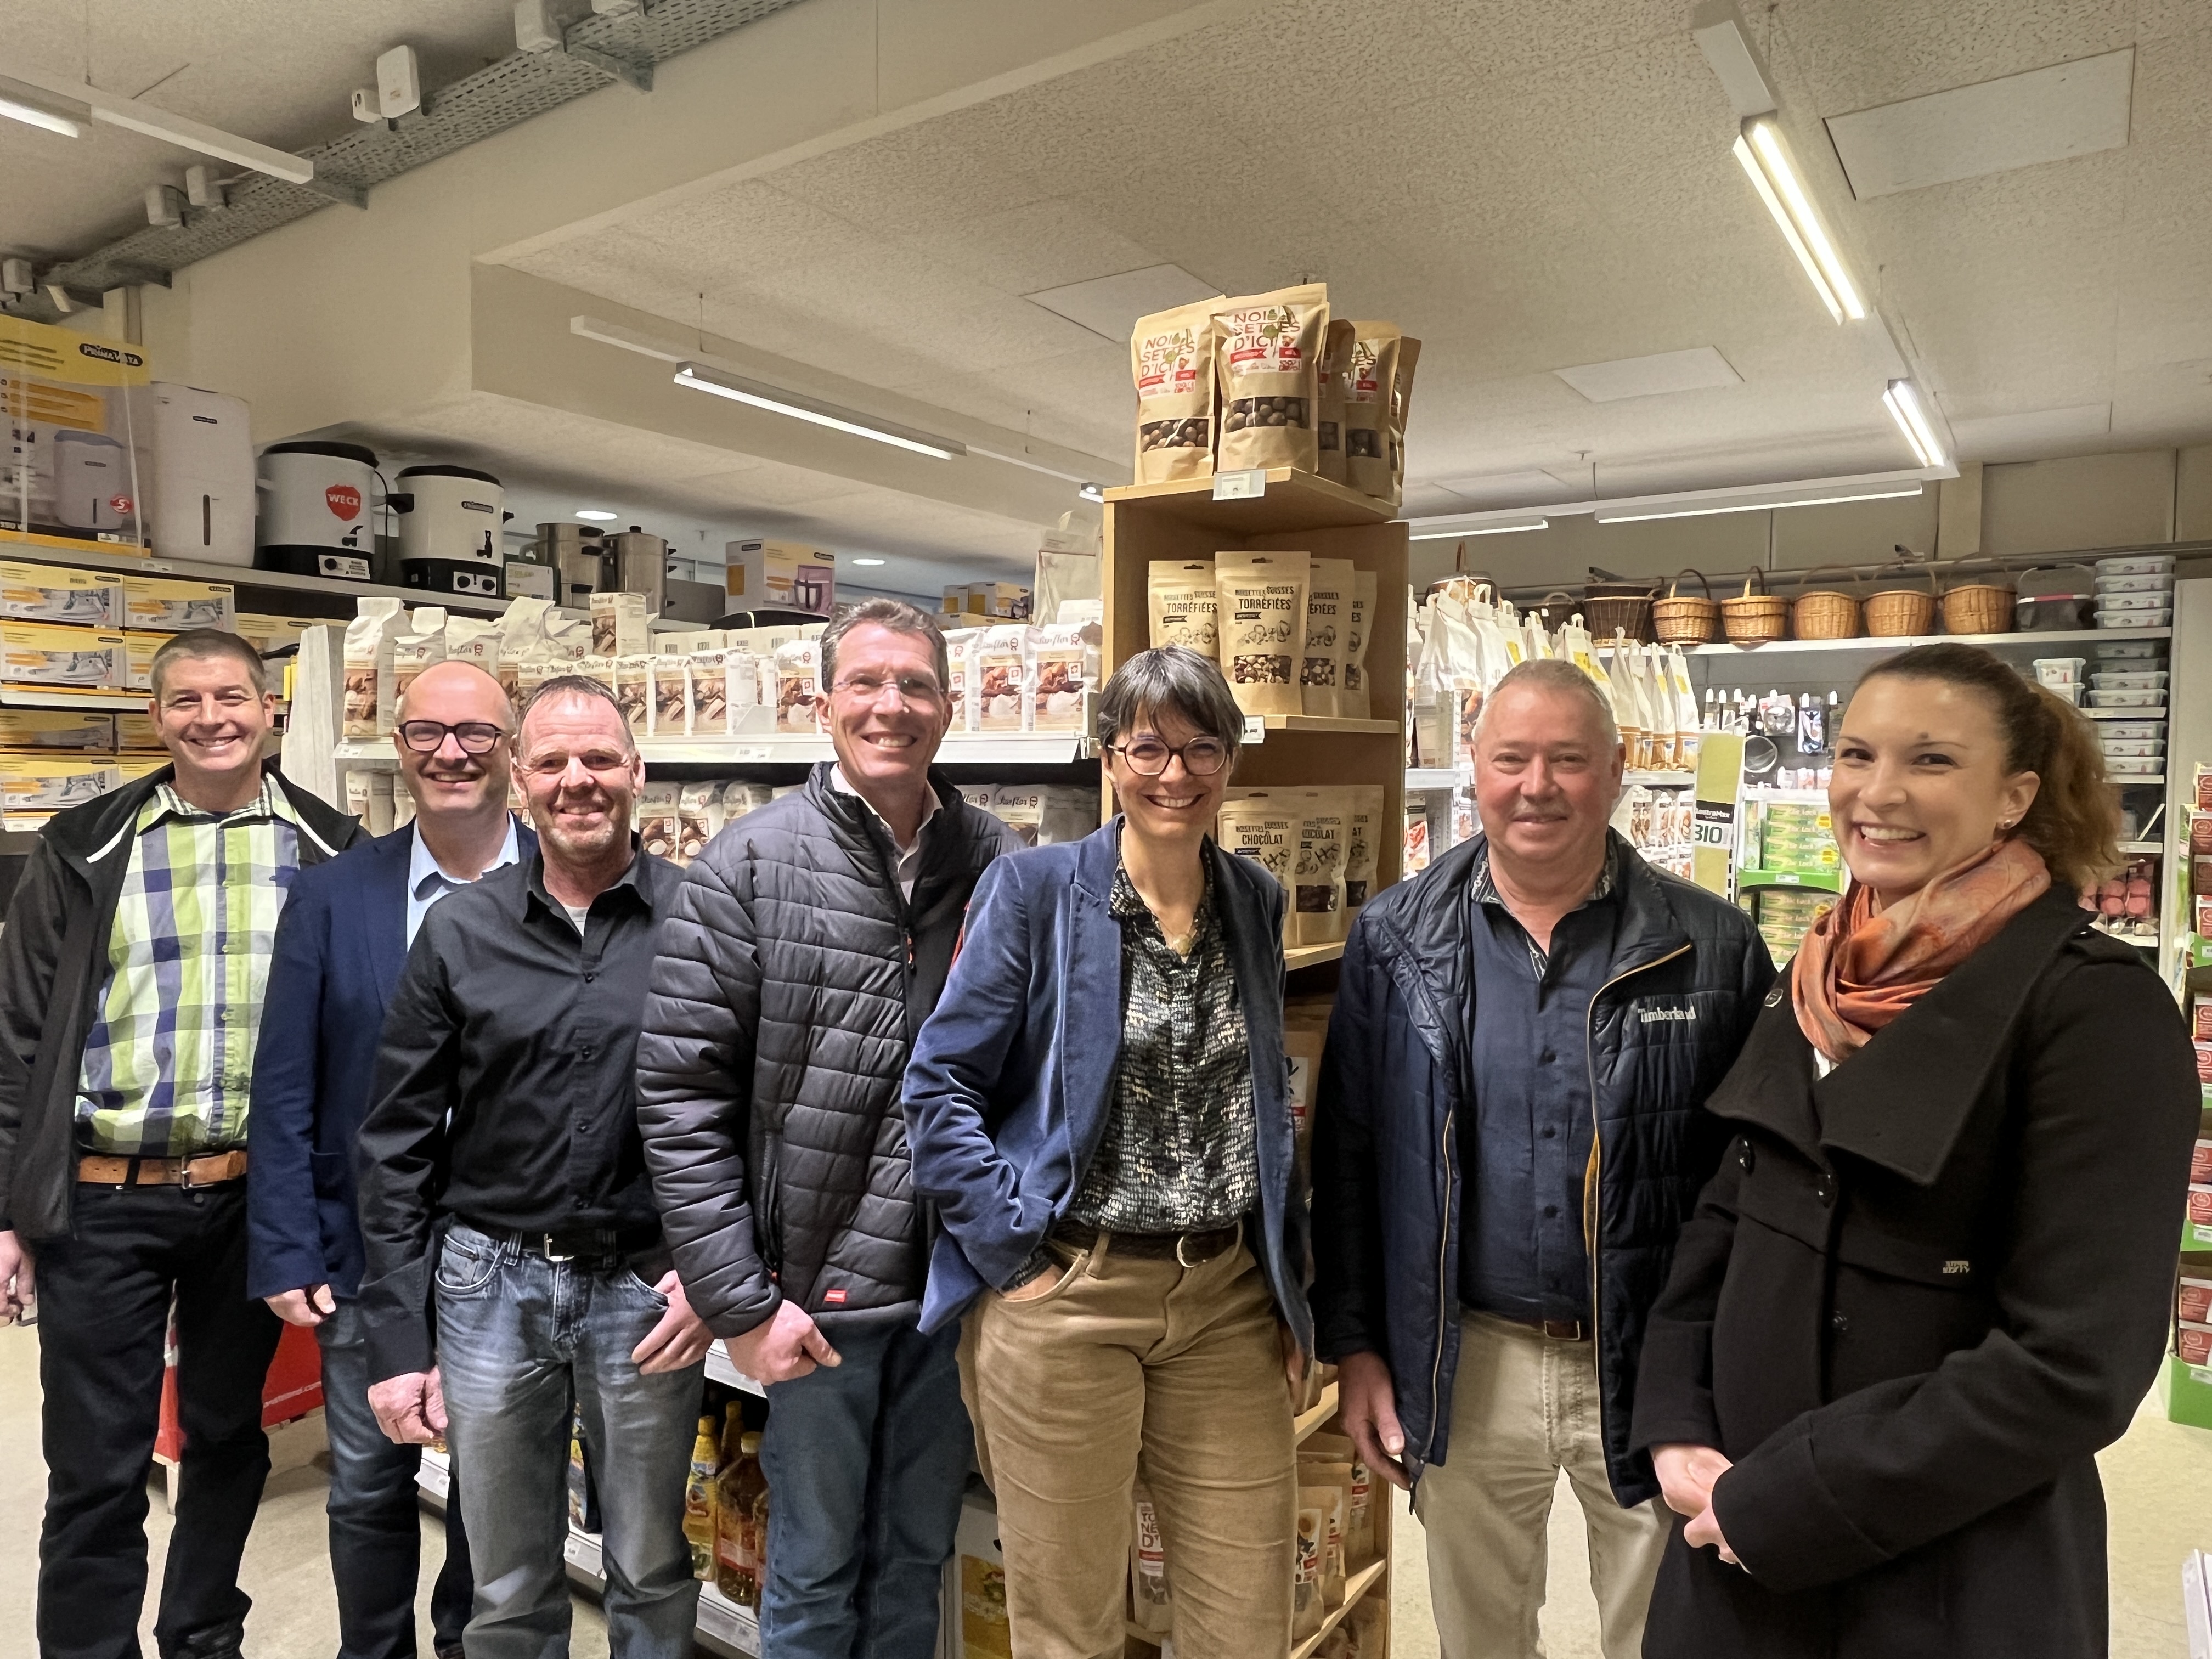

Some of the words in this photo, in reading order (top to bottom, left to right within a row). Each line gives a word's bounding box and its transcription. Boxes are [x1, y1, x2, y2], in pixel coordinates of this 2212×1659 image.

[1235, 322, 1300, 336] SETES
[1235, 335, 1274, 351] D'ICI
[1142, 343, 1194, 363] SETES
[1142, 363, 1172, 377] D'ICI
[328, 494, 359, 505] WECK
[1239, 598, 1292, 610] TORRÉFIÉES
[1242, 834, 1283, 845] CHOCOLAT
